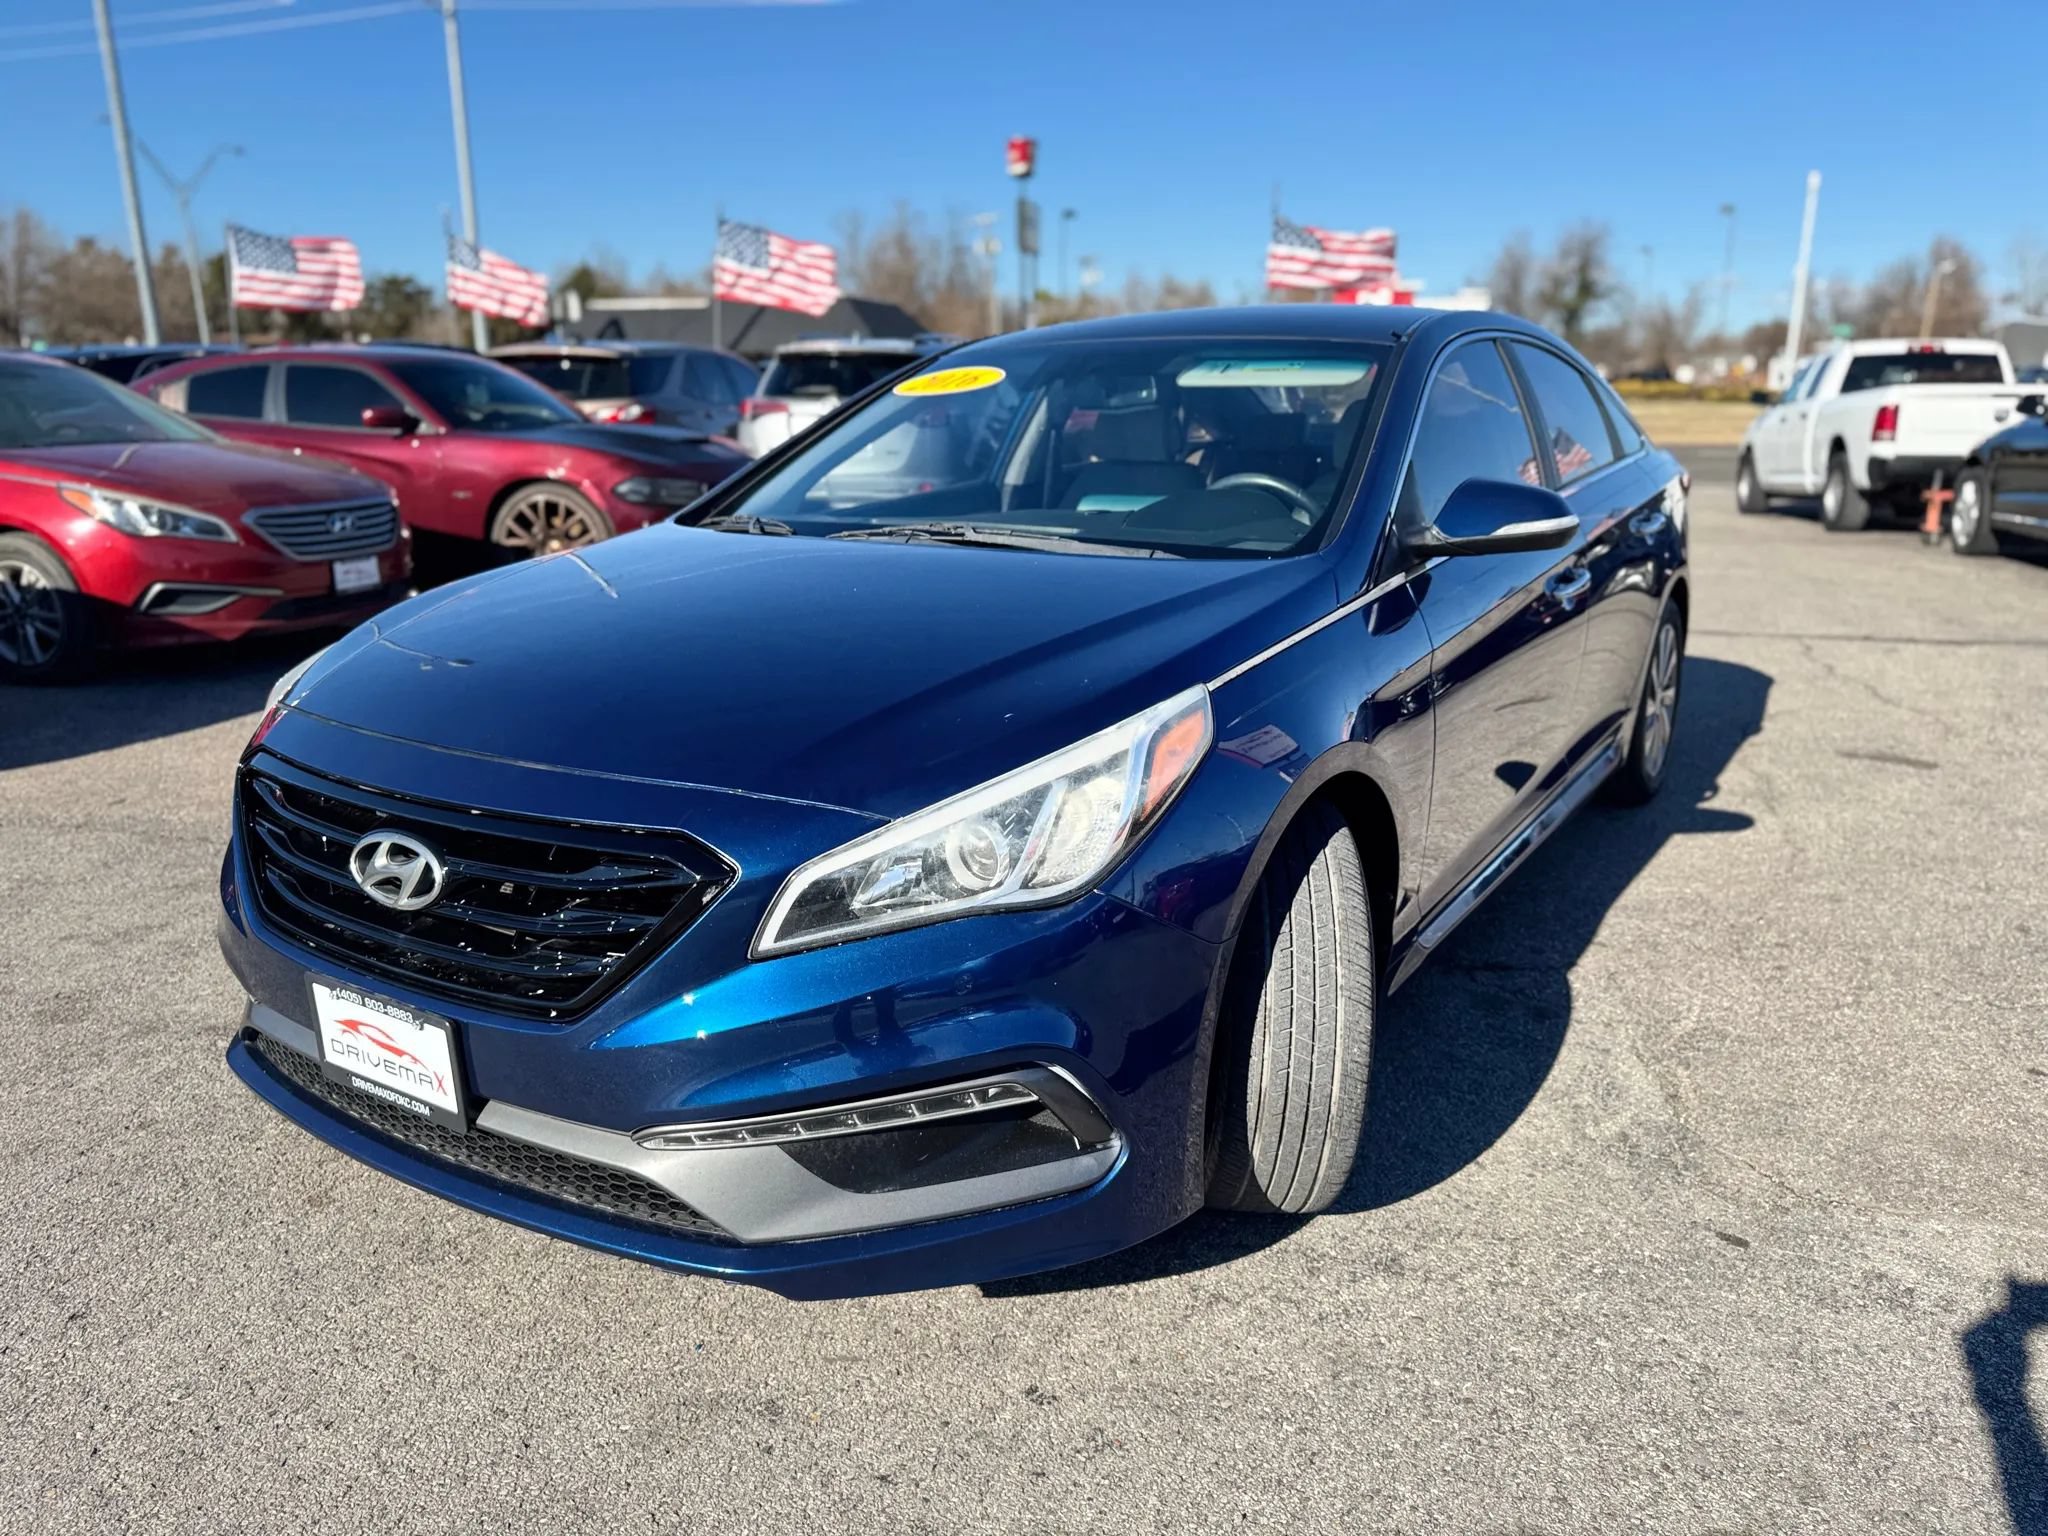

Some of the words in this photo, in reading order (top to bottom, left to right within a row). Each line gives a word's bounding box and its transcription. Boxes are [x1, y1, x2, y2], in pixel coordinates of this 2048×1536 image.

[336, 987, 363, 1006] (405)
[331, 1038, 448, 1096] DRIVEMAX
[351, 1075, 430, 1117] DRIVEMAXOFOKC.COM
